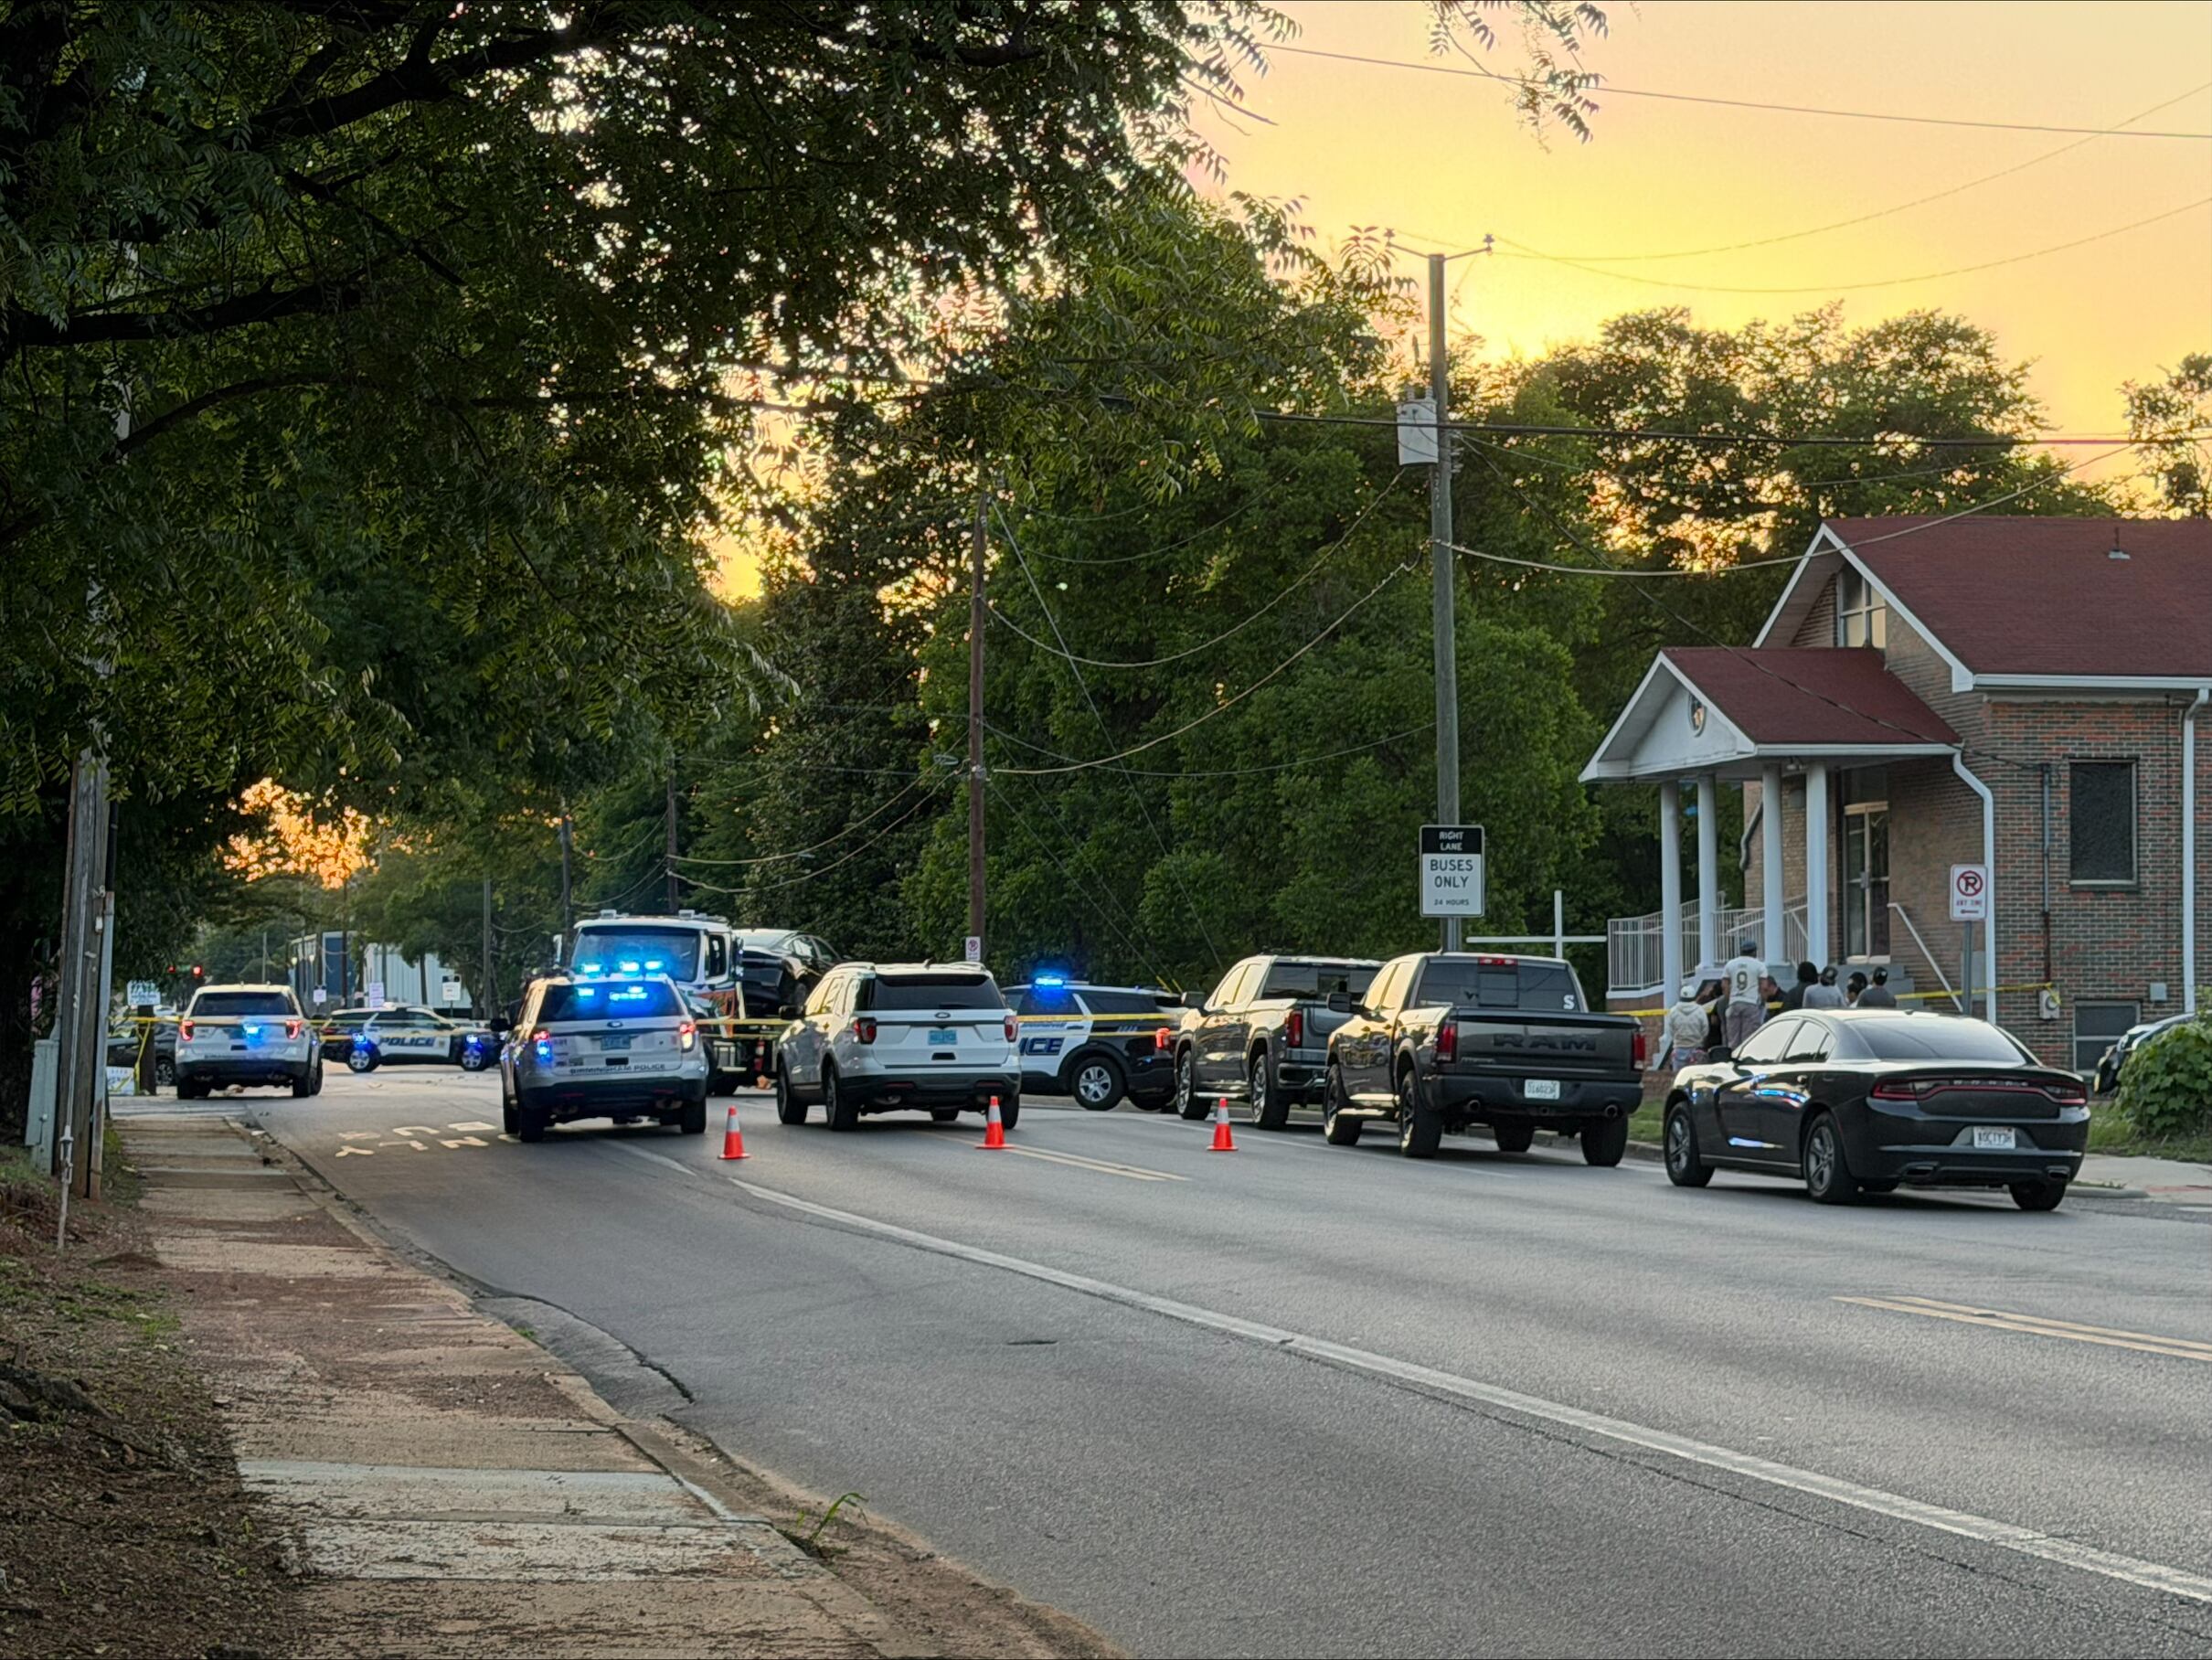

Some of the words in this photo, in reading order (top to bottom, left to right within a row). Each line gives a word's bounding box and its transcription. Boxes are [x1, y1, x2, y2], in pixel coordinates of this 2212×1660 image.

[1439, 831, 1464, 840] RIGHT
[1440, 842, 1462, 851] LANE
[1430, 859, 1473, 871] BUSES
[1434, 876, 1469, 888] ONLY
[1737, 971, 1748, 991] 9
[1563, 995, 1574, 1010] S
[379, 1037, 435, 1047] POLICE
[1018, 1038, 1065, 1056] ICE
[1493, 1033, 1595, 1050] RAM
